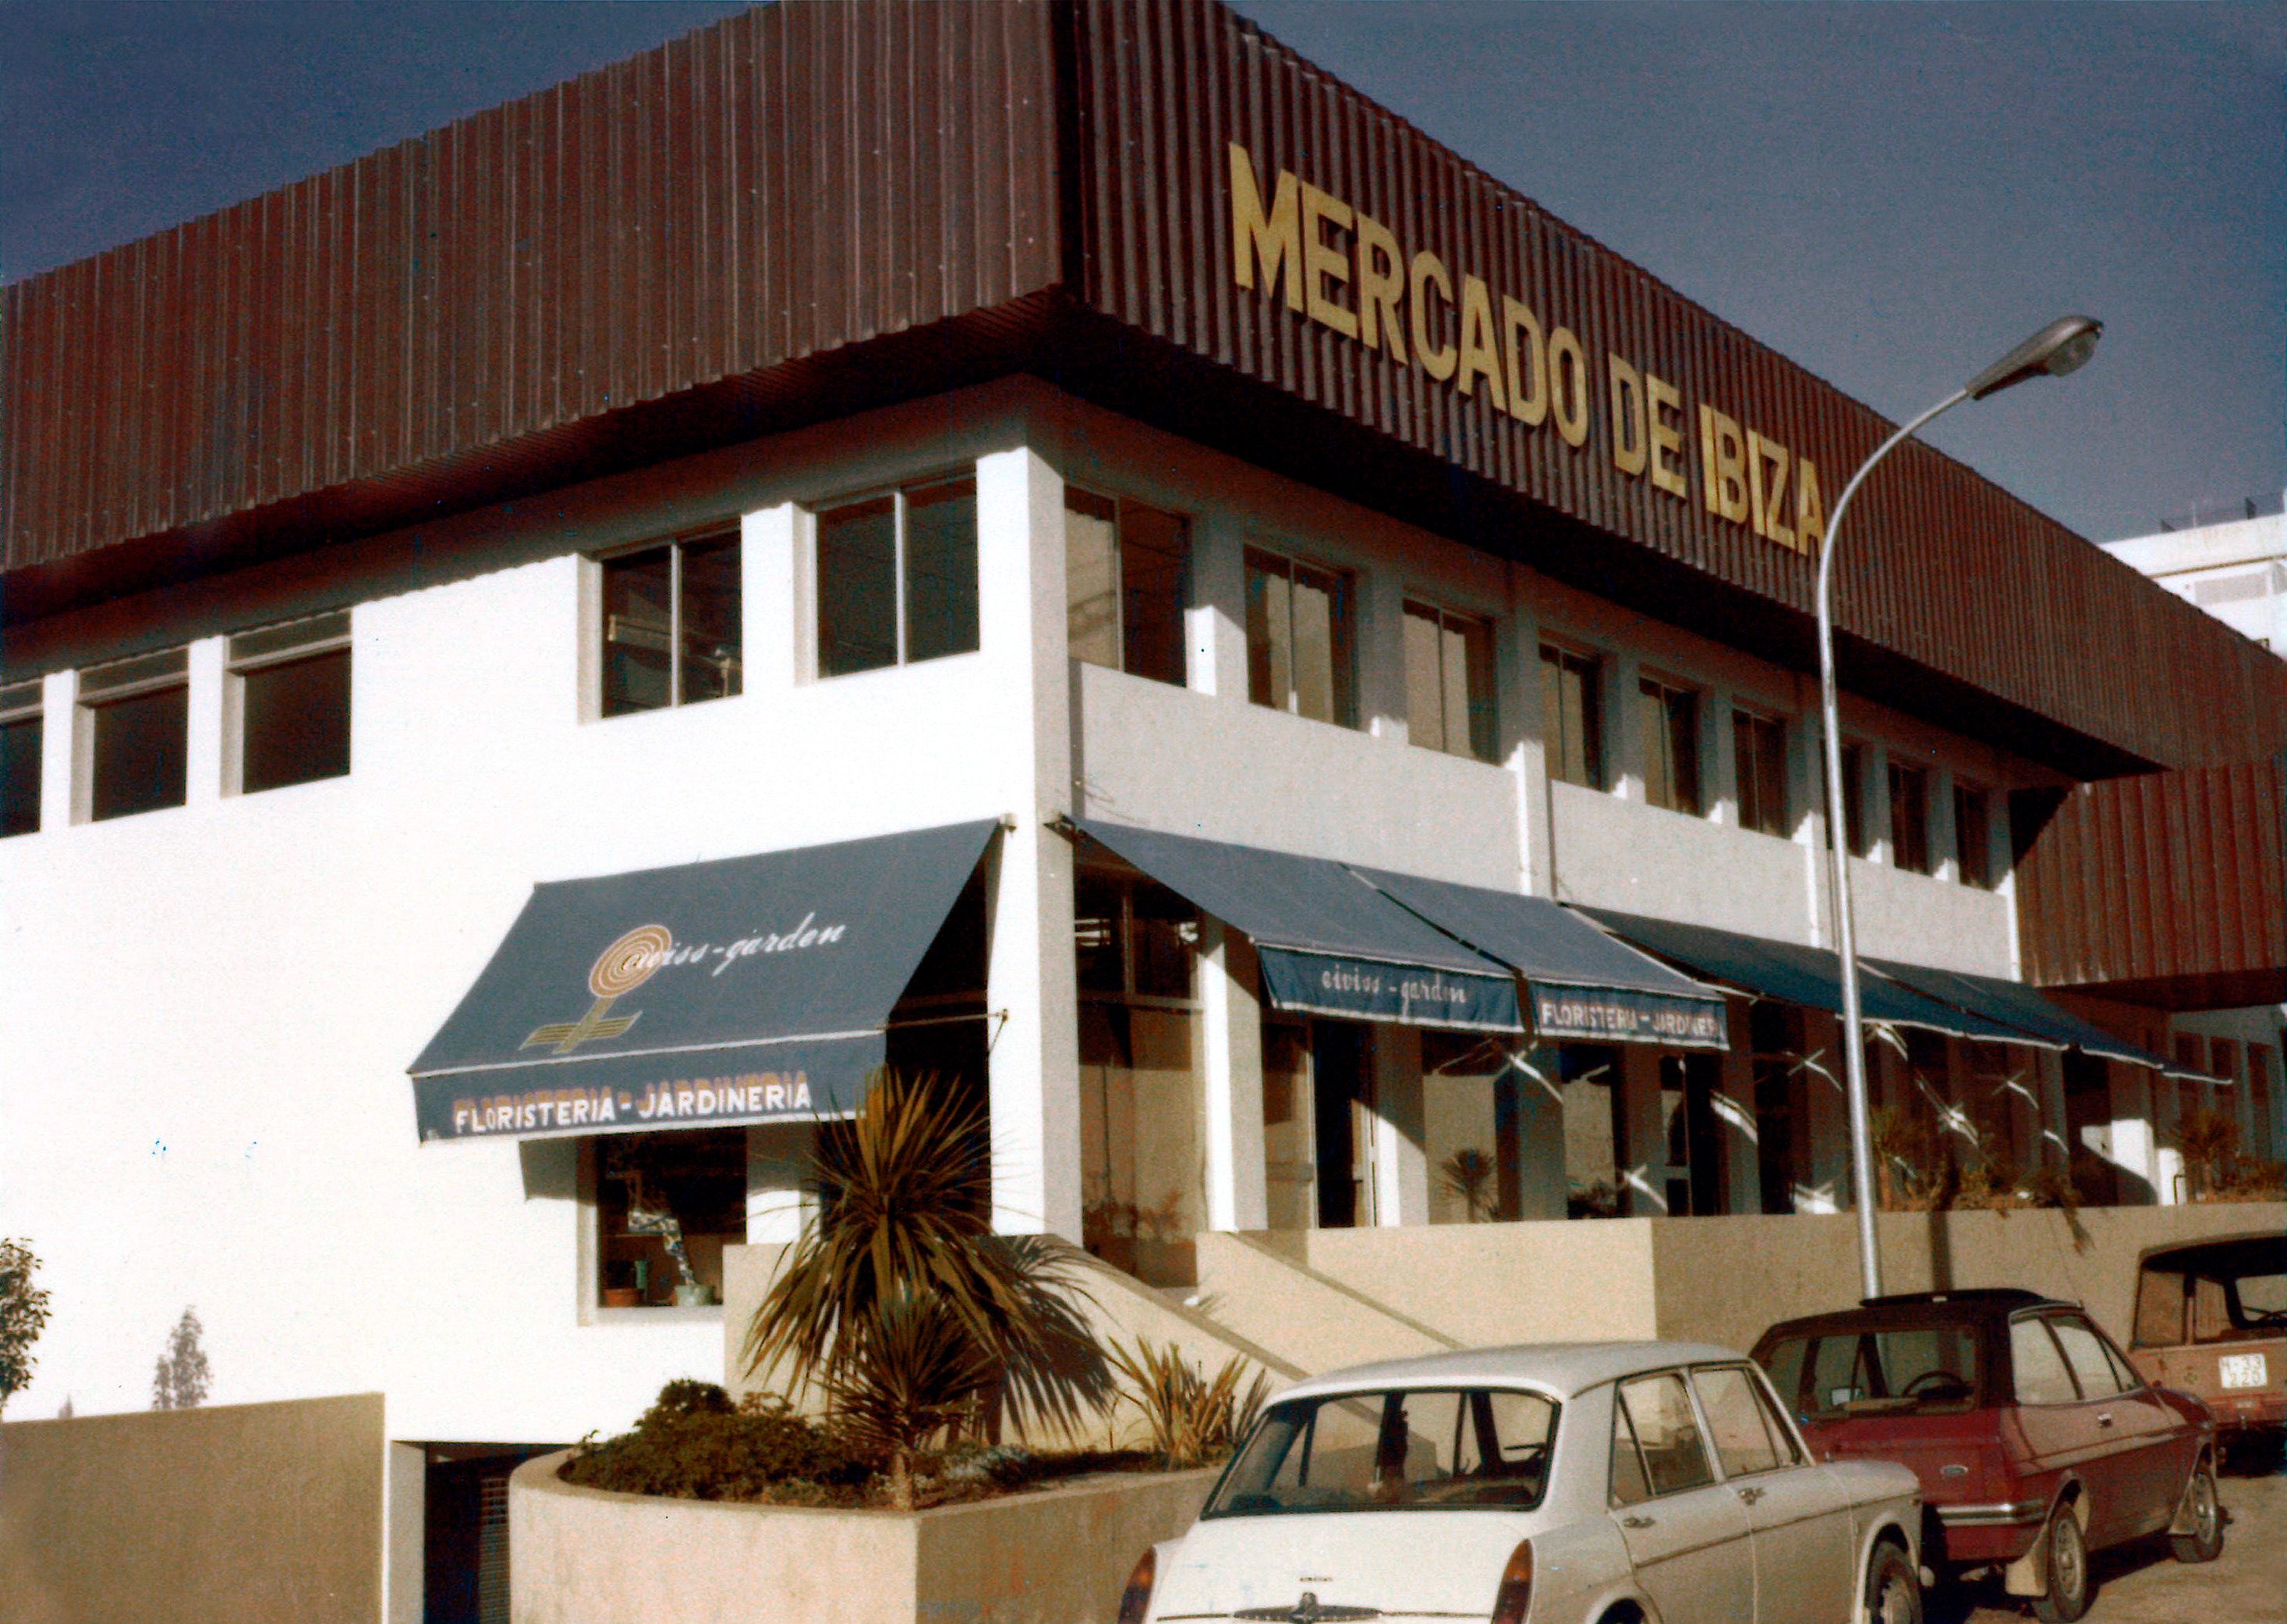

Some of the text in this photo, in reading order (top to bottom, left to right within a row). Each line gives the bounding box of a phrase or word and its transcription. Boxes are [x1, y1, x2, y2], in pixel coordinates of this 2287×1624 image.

[1228, 141, 1825, 558] MERCADO DE IBIZA
